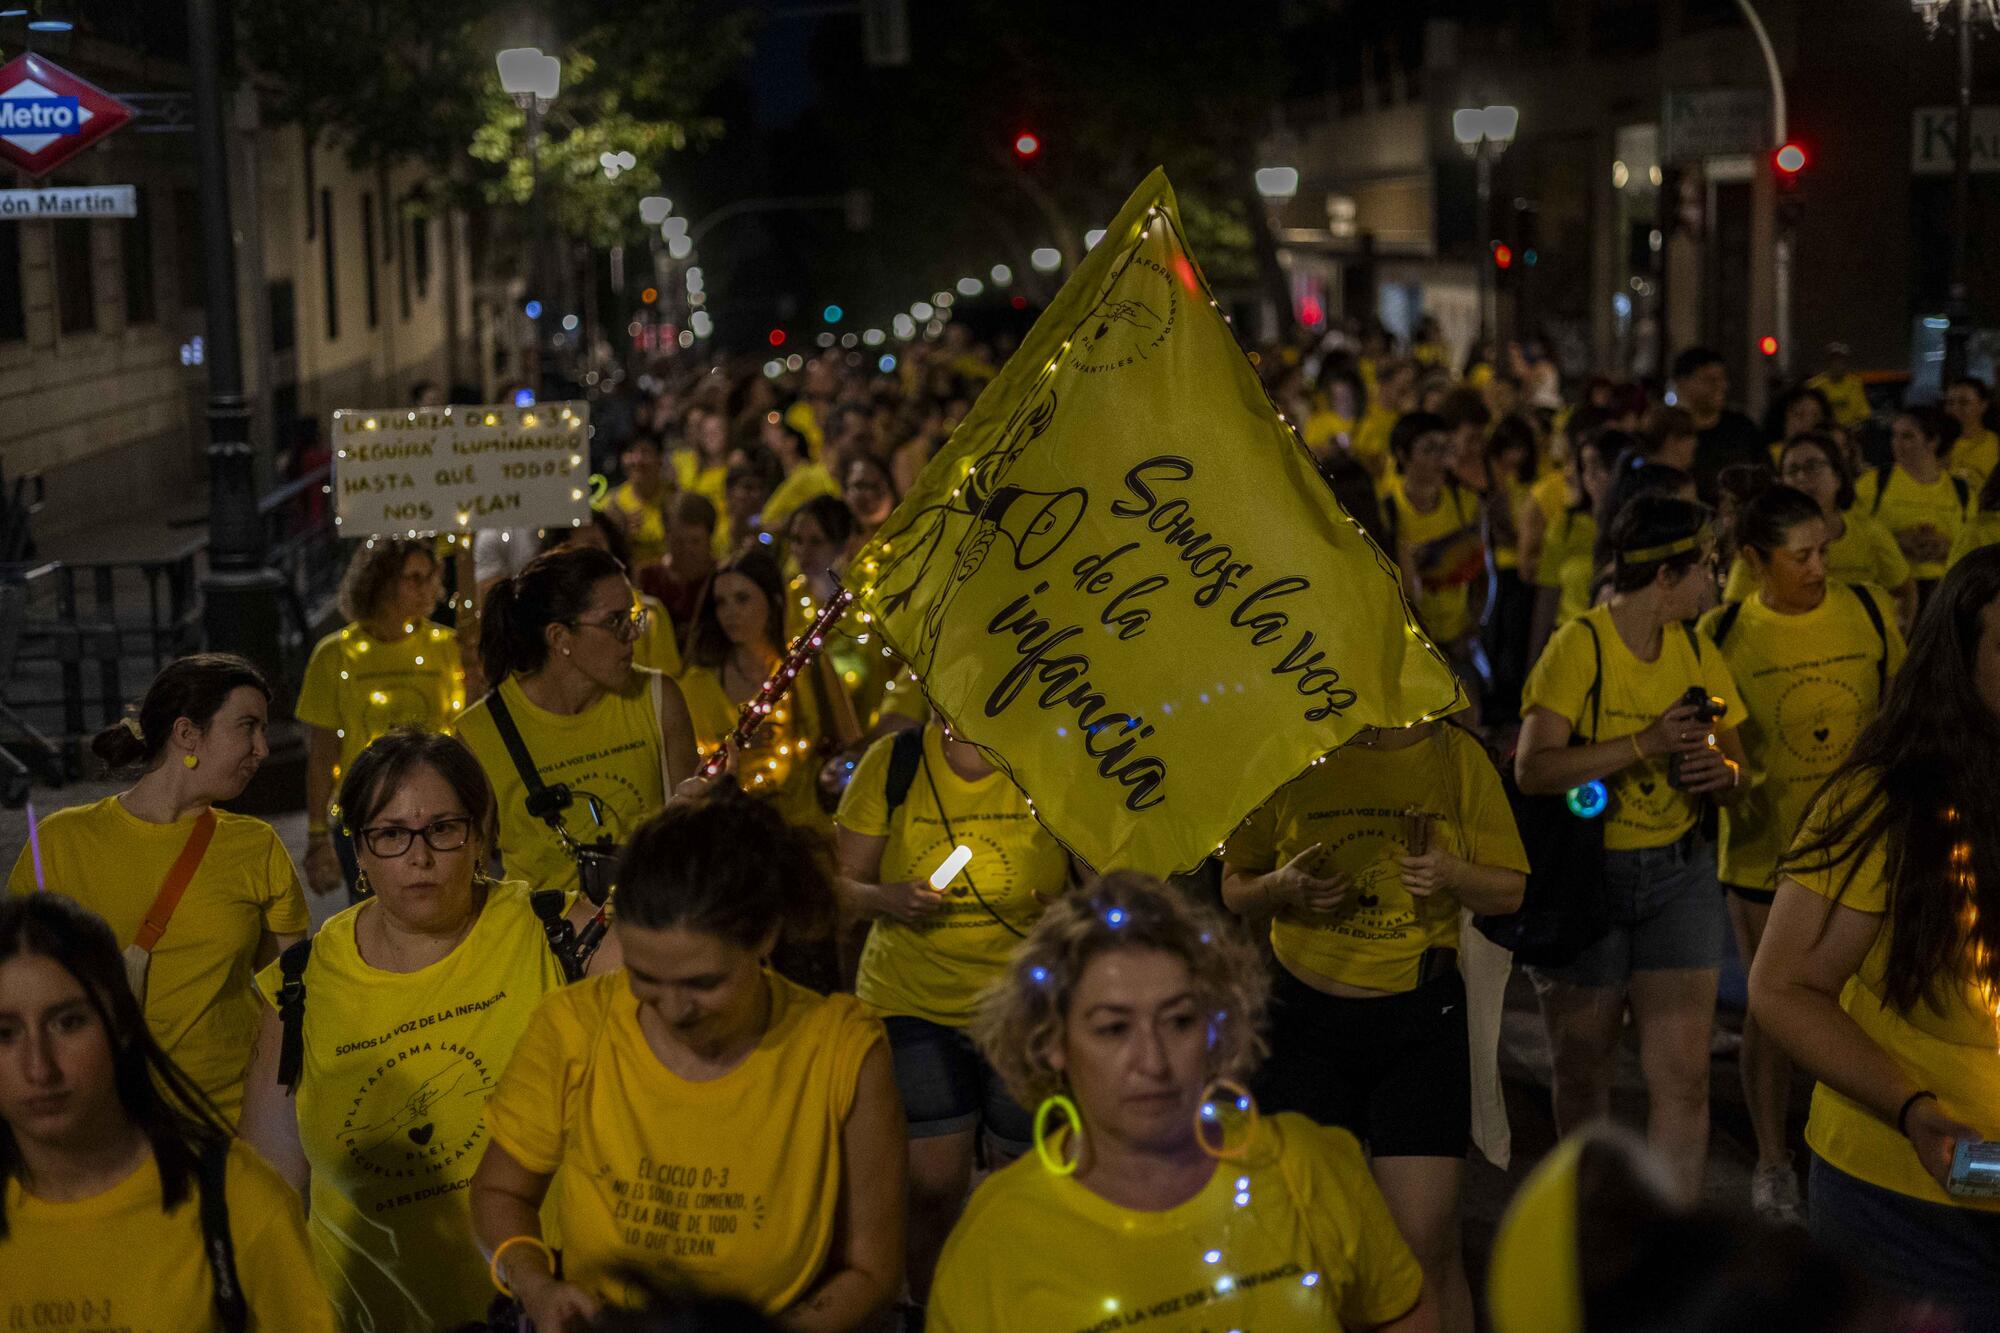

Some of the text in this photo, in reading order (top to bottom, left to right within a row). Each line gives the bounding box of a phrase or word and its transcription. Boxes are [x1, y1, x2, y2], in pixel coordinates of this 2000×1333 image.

[0, 102, 74, 129] Metro
[0, 195, 30, 214] ón
[344, 472, 415, 496] HASTA
[502, 459, 571, 480] TODOS
[384, 501, 434, 521] NOS
[1111, 455, 1253, 608] Somos
[1230, 575, 1311, 647] la
[1072, 542, 1170, 641] de la
[984, 580, 1167, 812] infancia
[1356, 807, 1376, 817] VOZ
[1378, 808, 1391, 817] DE
[335, 1037, 378, 1056] SOMOS
[379, 1032, 392, 1045] LA
[393, 1020, 417, 1037] VOZ
[419, 1015, 436, 1029] DE
[437, 1009, 454, 1022] LA
[343, 1042, 432, 1128] PLATAFORMA
[638, 1157, 730, 1189] EL CICLO 0-3
[414, 1178, 472, 1202] EDUCACI
[612, 1178, 630, 1196] NO
[632, 1181, 646, 1201] ES
[677, 1190, 689, 1209] EL
[615, 1199, 738, 1235] ES LA BASE DE TODO
[623, 1226, 641, 1245] LO
[644, 1230, 669, 1251] QUE
